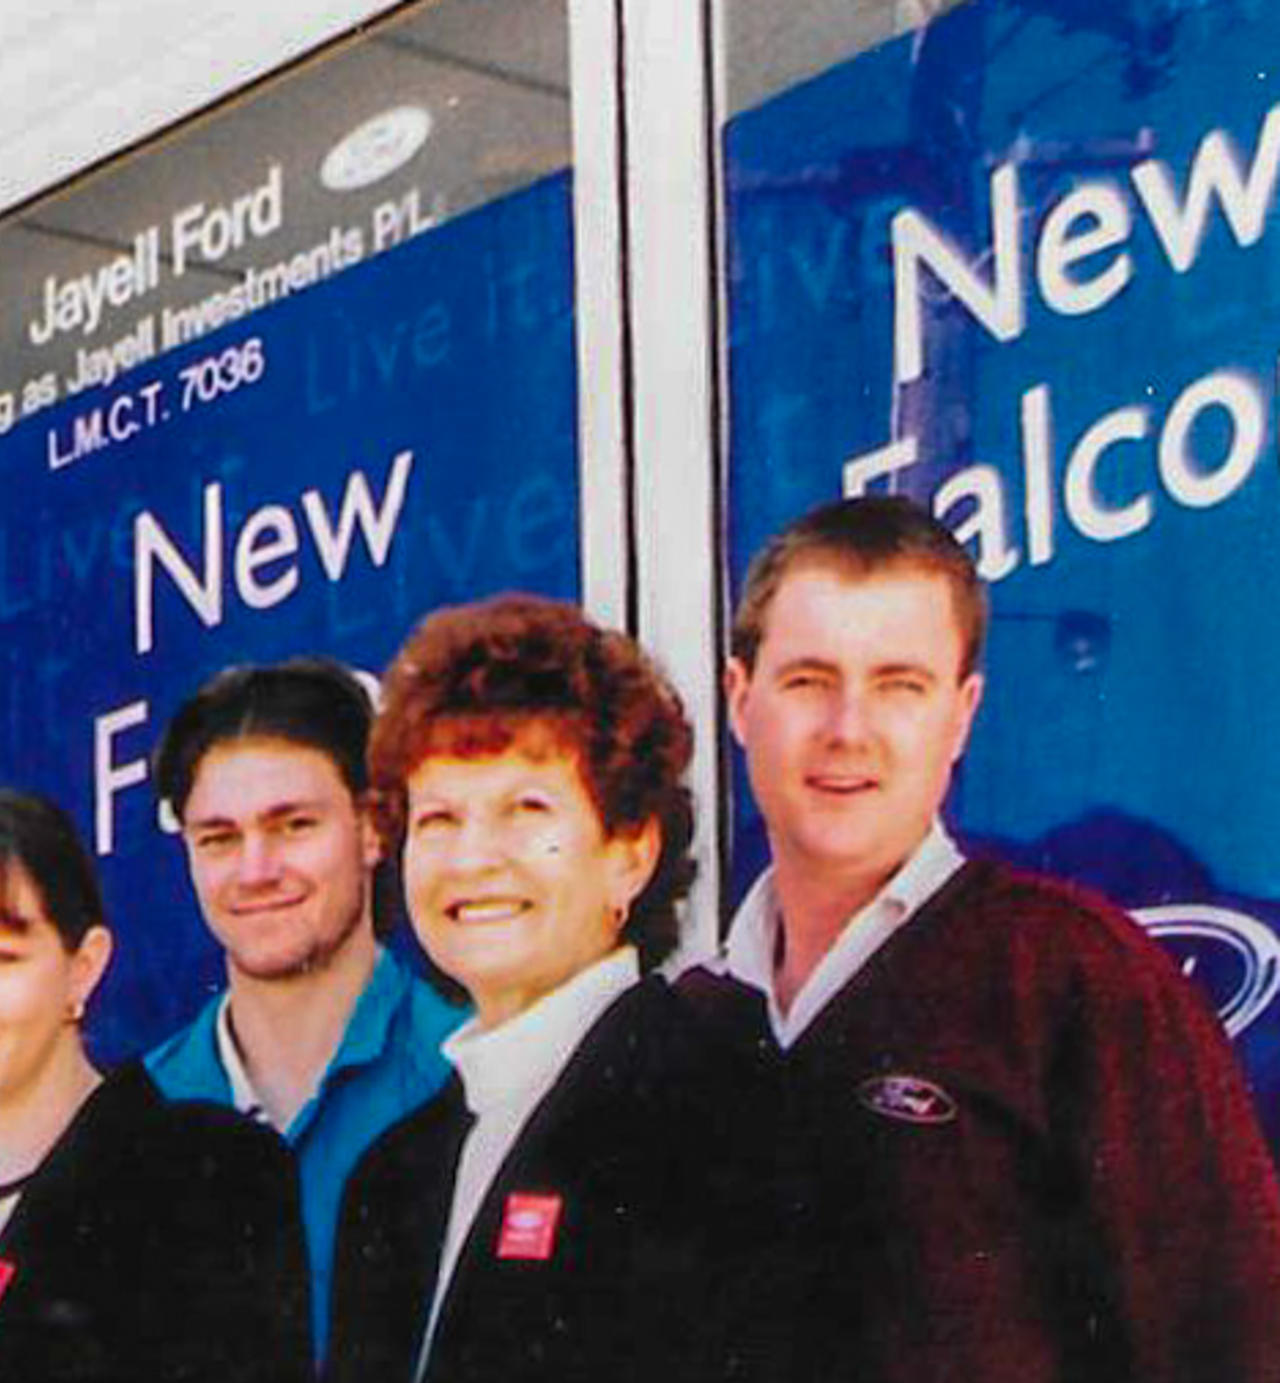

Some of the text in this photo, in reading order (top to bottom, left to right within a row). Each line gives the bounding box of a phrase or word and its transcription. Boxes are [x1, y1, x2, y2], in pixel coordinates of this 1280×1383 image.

[22, 375, 57, 414] as
[66, 326, 156, 397] Jayell
[162, 236, 363, 350] Investments
[30, 165, 283, 345] Jayell Ford
[890, 102, 1280, 383] New
[47, 336, 266, 470] L.M.C.T. 7036
[843, 370, 1264, 582] alco
[134, 451, 414, 654] New
